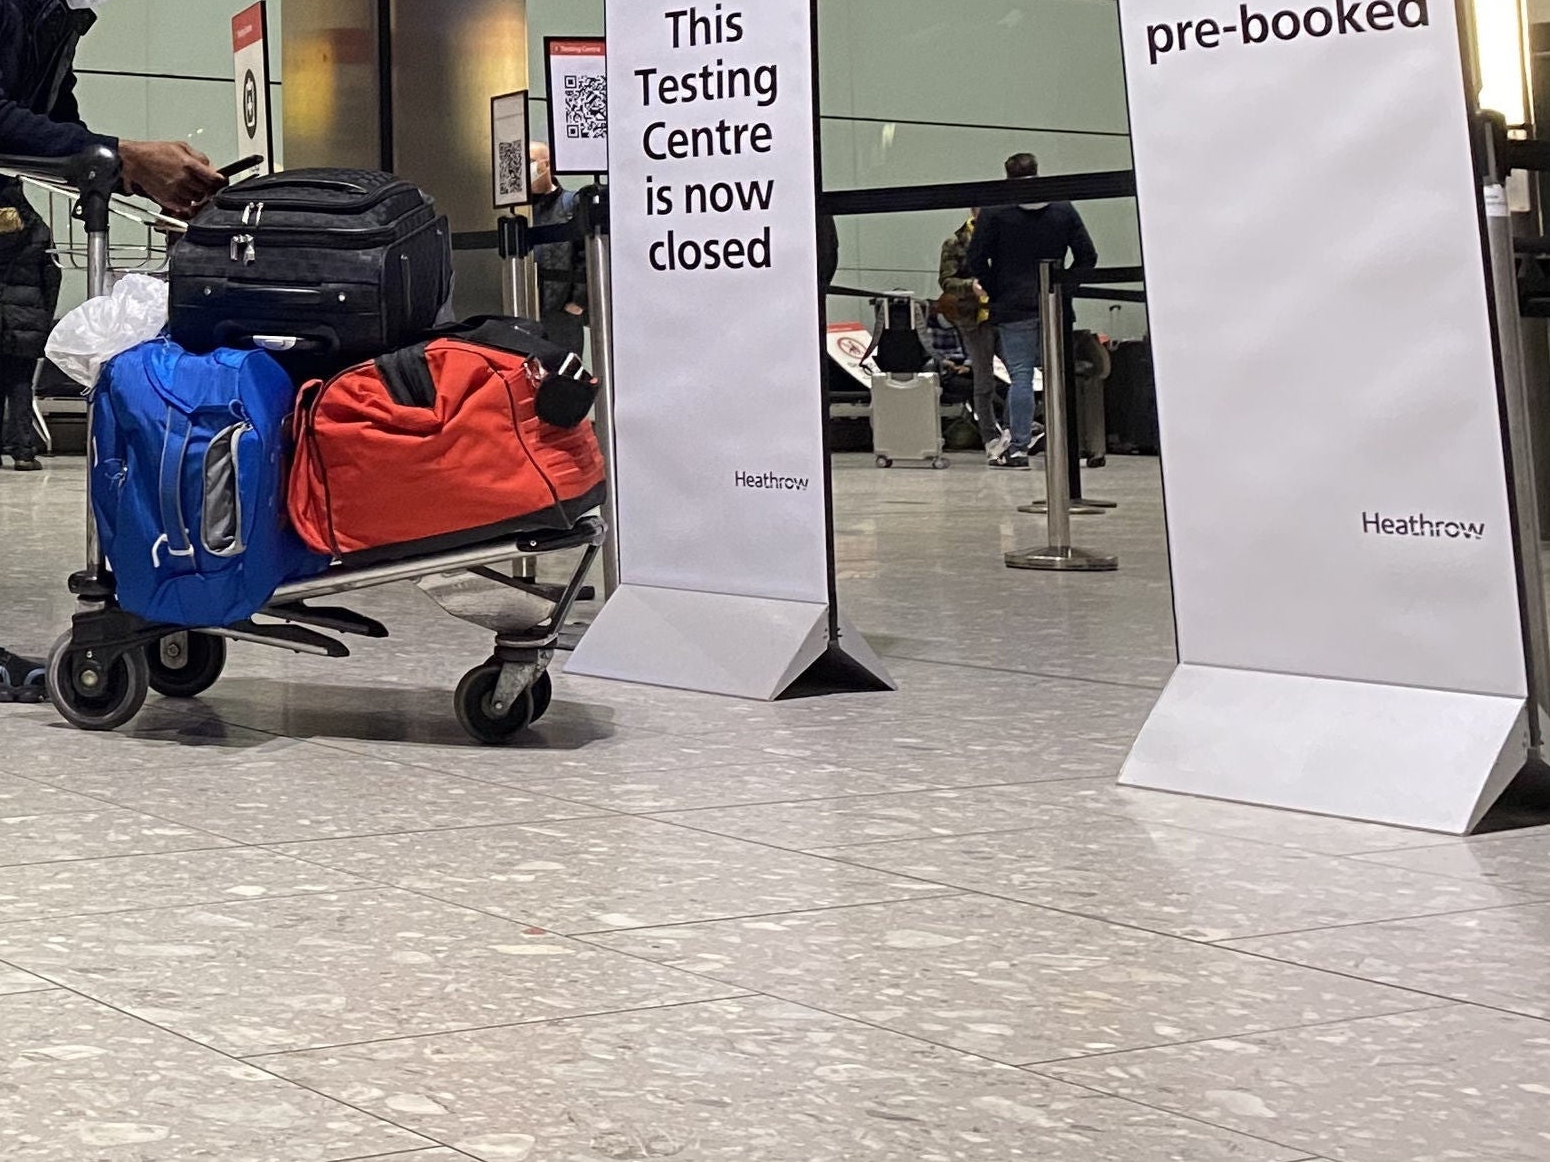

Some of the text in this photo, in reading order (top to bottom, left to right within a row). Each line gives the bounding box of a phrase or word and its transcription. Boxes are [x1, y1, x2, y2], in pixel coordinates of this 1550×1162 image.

[665, 4, 743, 48] This
[634, 59, 778, 106] Testing
[642, 119, 772, 160] Centre
[646, 176, 774, 216] is now
[649, 226, 772, 270] closed
[735, 470, 809, 491] Heathrow
[1362, 512, 1484, 539] Heathrow
